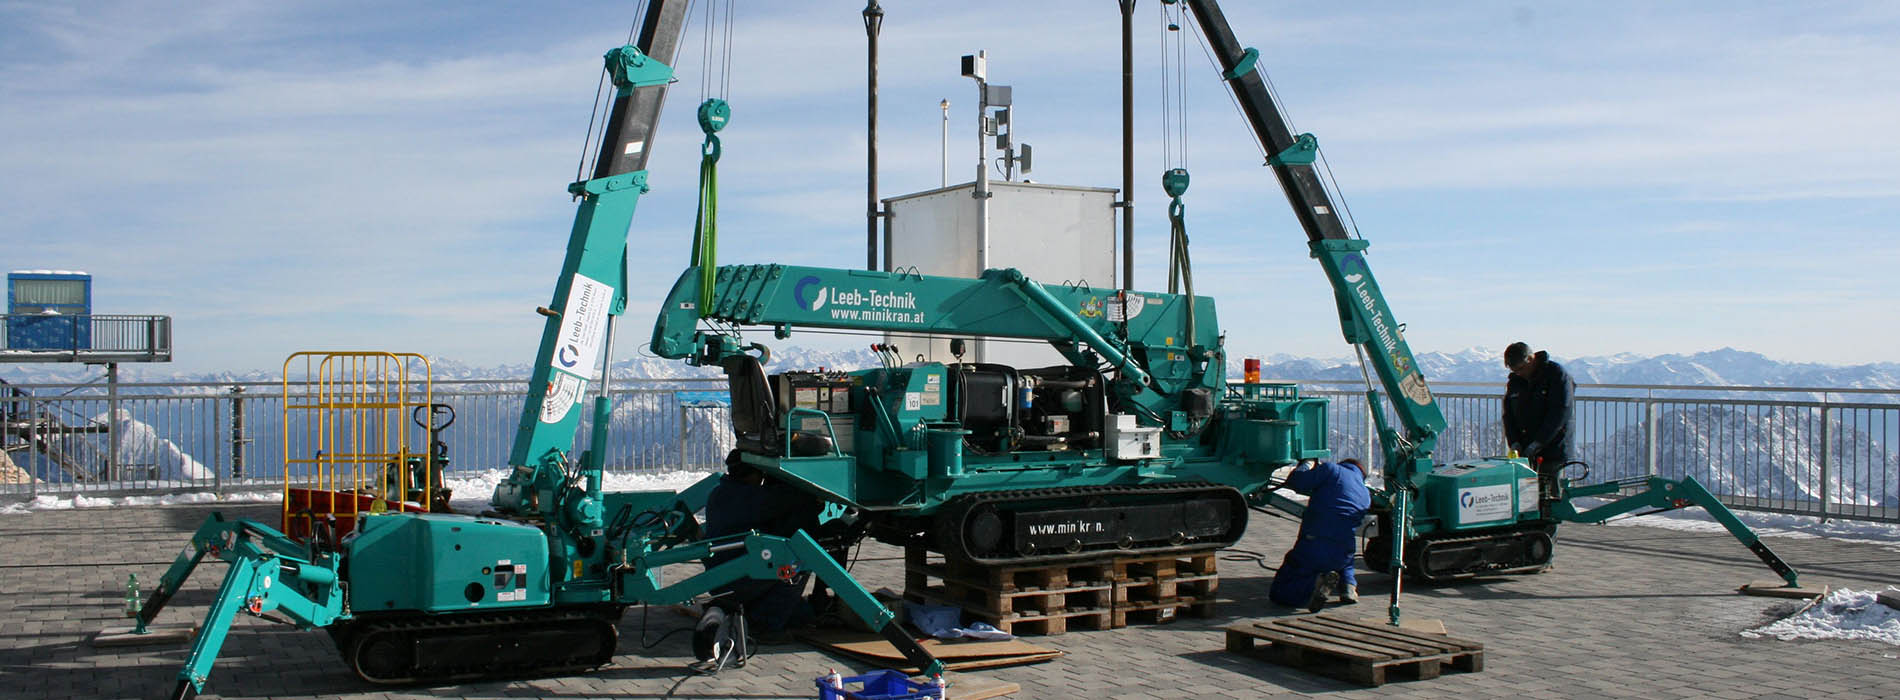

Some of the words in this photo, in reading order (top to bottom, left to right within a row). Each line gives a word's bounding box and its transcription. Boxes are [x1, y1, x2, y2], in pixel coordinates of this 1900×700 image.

[570, 283, 593, 343] Leeb-Technik
[831, 287, 916, 310] Leeb-Technik
[831, 308, 924, 324] www.minikran.at
[1356, 282, 1396, 354] Leeb-Technik
